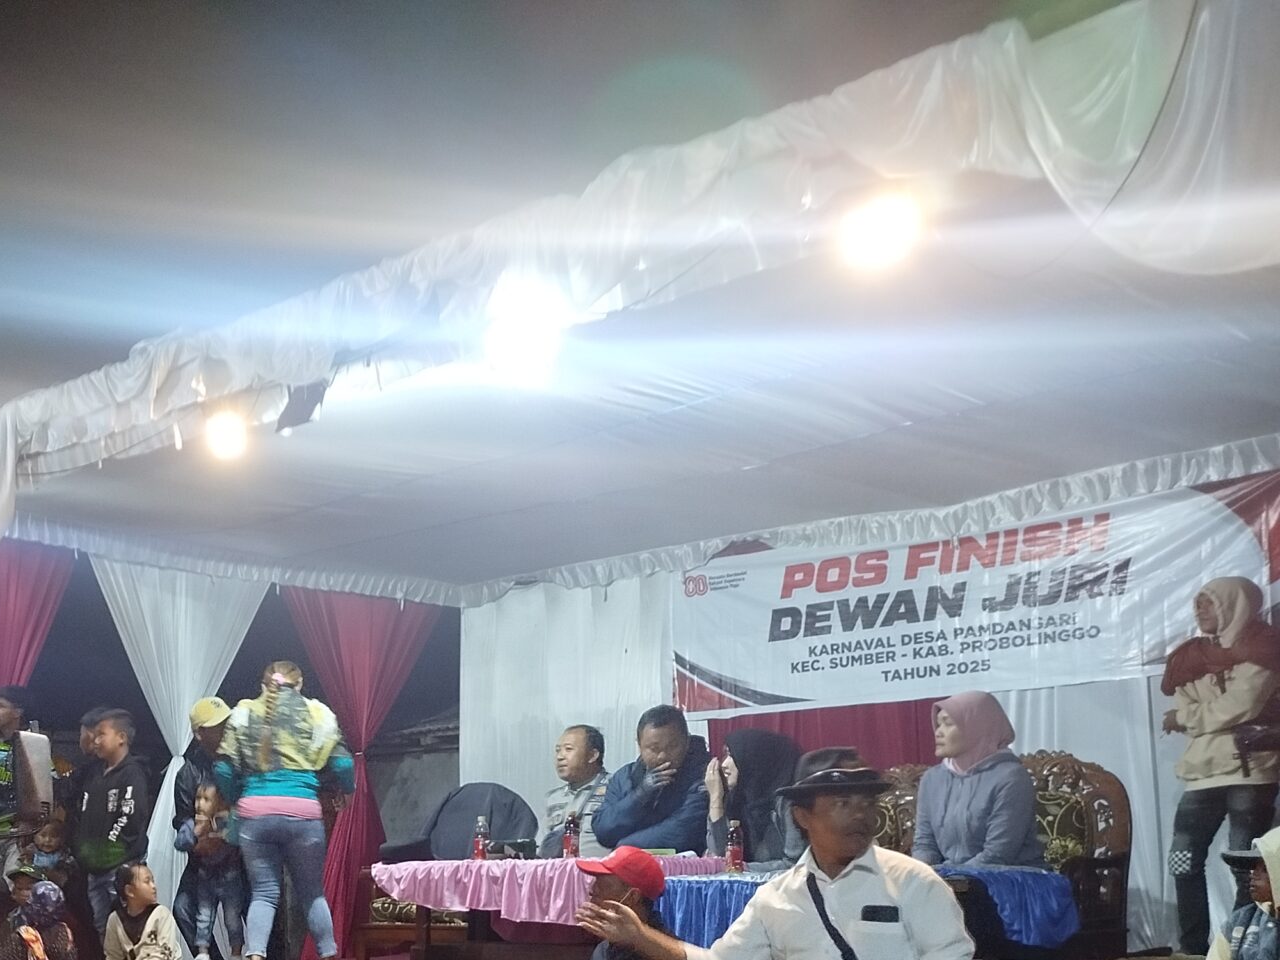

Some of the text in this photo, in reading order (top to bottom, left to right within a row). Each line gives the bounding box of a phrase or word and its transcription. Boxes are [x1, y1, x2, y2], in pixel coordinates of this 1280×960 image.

[780, 512, 1111, 599] POS FINISH
[768, 557, 1132, 642] DEWAN JURI
[790, 660, 825, 674] KEC.
[829, 651, 898, 670] SUMBER
[913, 644, 954, 660] KAB.
[960, 625, 1102, 654] PROBOLINGGO
[808, 638, 896, 658] KARNAVAL
[901, 630, 948, 648] DESA
[881, 659, 991, 682] TAHUN 2025
